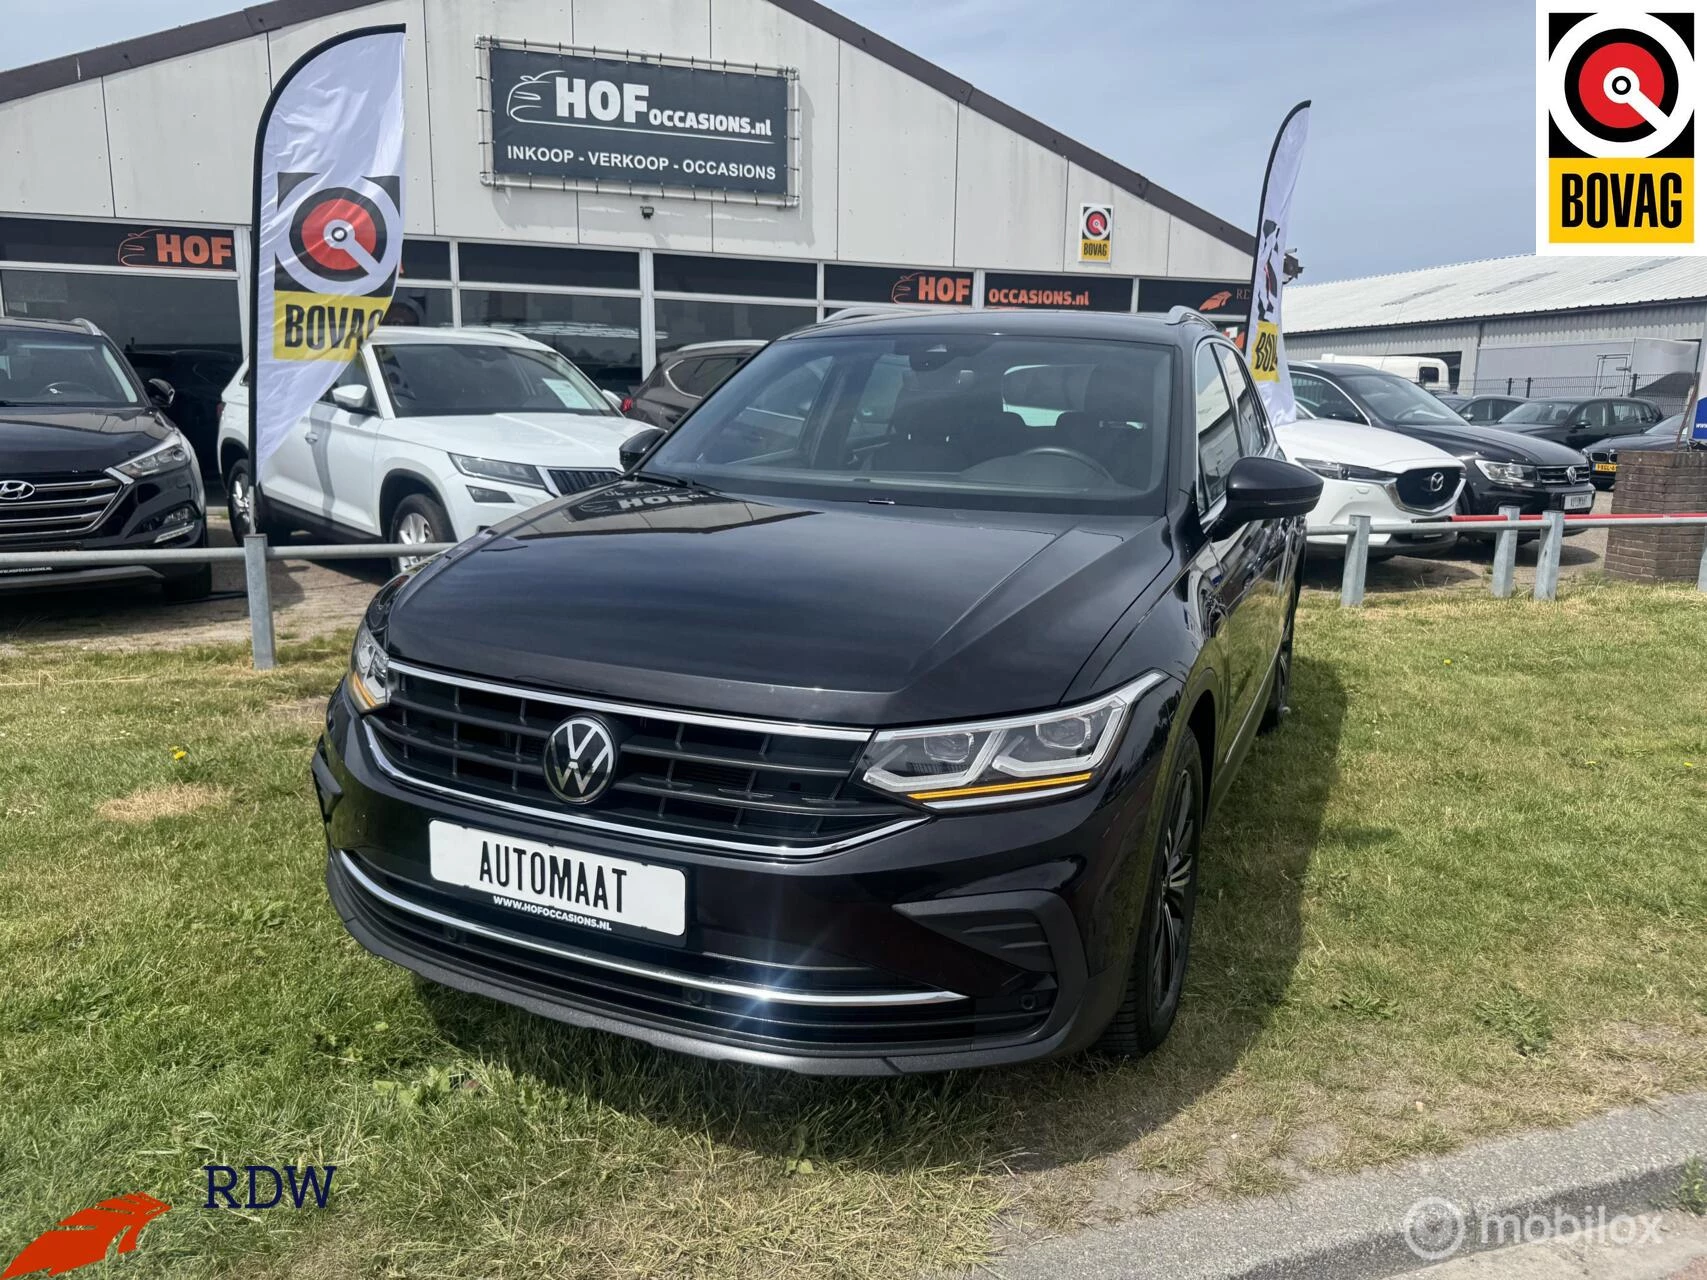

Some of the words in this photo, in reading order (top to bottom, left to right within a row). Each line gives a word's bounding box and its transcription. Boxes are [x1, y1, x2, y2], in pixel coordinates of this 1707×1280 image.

[555, 76, 649, 123] HOF
[649, 108, 772, 136] OCCASIONS.nl
[507, 145, 574, 163] INKOOP
[588, 151, 669, 171] VERKOOP
[682, 159, 776, 181] OCCASIONS
[156, 233, 233, 265] HOF
[1083, 243, 1108, 257] BOVAG
[918, 276, 971, 303] HOF
[988, 288, 1090, 306] OCCASIONS.nl
[479, 841, 627, 913] AUTOMAAT
[493, 895, 613, 932] WWW.HOFOCCASIONS.NL
